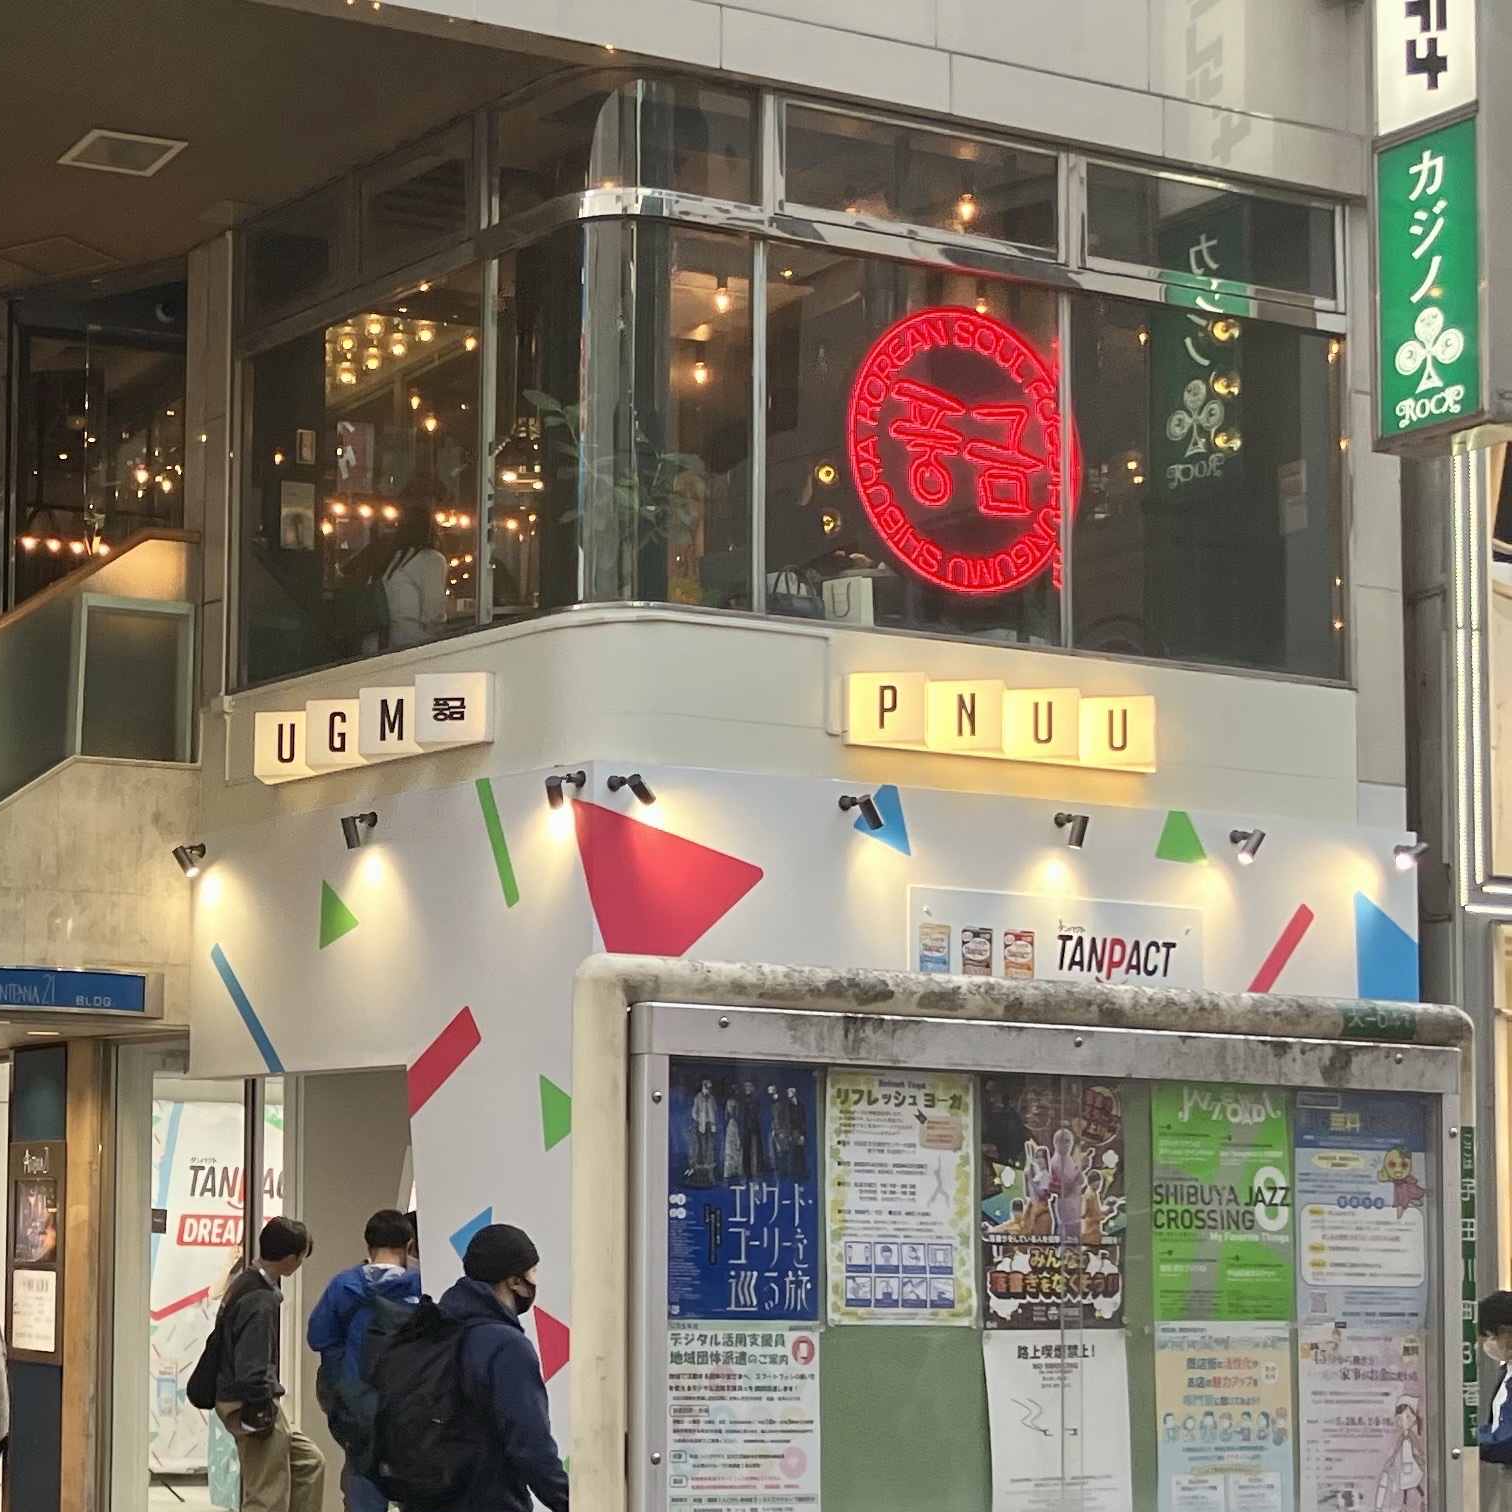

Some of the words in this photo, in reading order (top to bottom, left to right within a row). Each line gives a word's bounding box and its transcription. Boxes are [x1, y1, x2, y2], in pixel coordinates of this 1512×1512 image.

[1409, 149, 1447, 303] カジノ
[857, 319, 948, 426] KOREAN
[952, 319, 1024, 384] SOUL
[1057, 934, 1177, 980] TANPACT
[76, 995, 112, 1007] BLDG
[835, 1087, 918, 1108] リフレッシュ
[923, 1092, 963, 1110] ヨーガ
[1153, 1184, 1240, 1206] SHIBUYA
[1244, 1186, 1291, 1207] JAZZ
[1153, 1208, 1255, 1231] CROSSING
[670, 1333, 786, 1348] デジタル活用支援員
